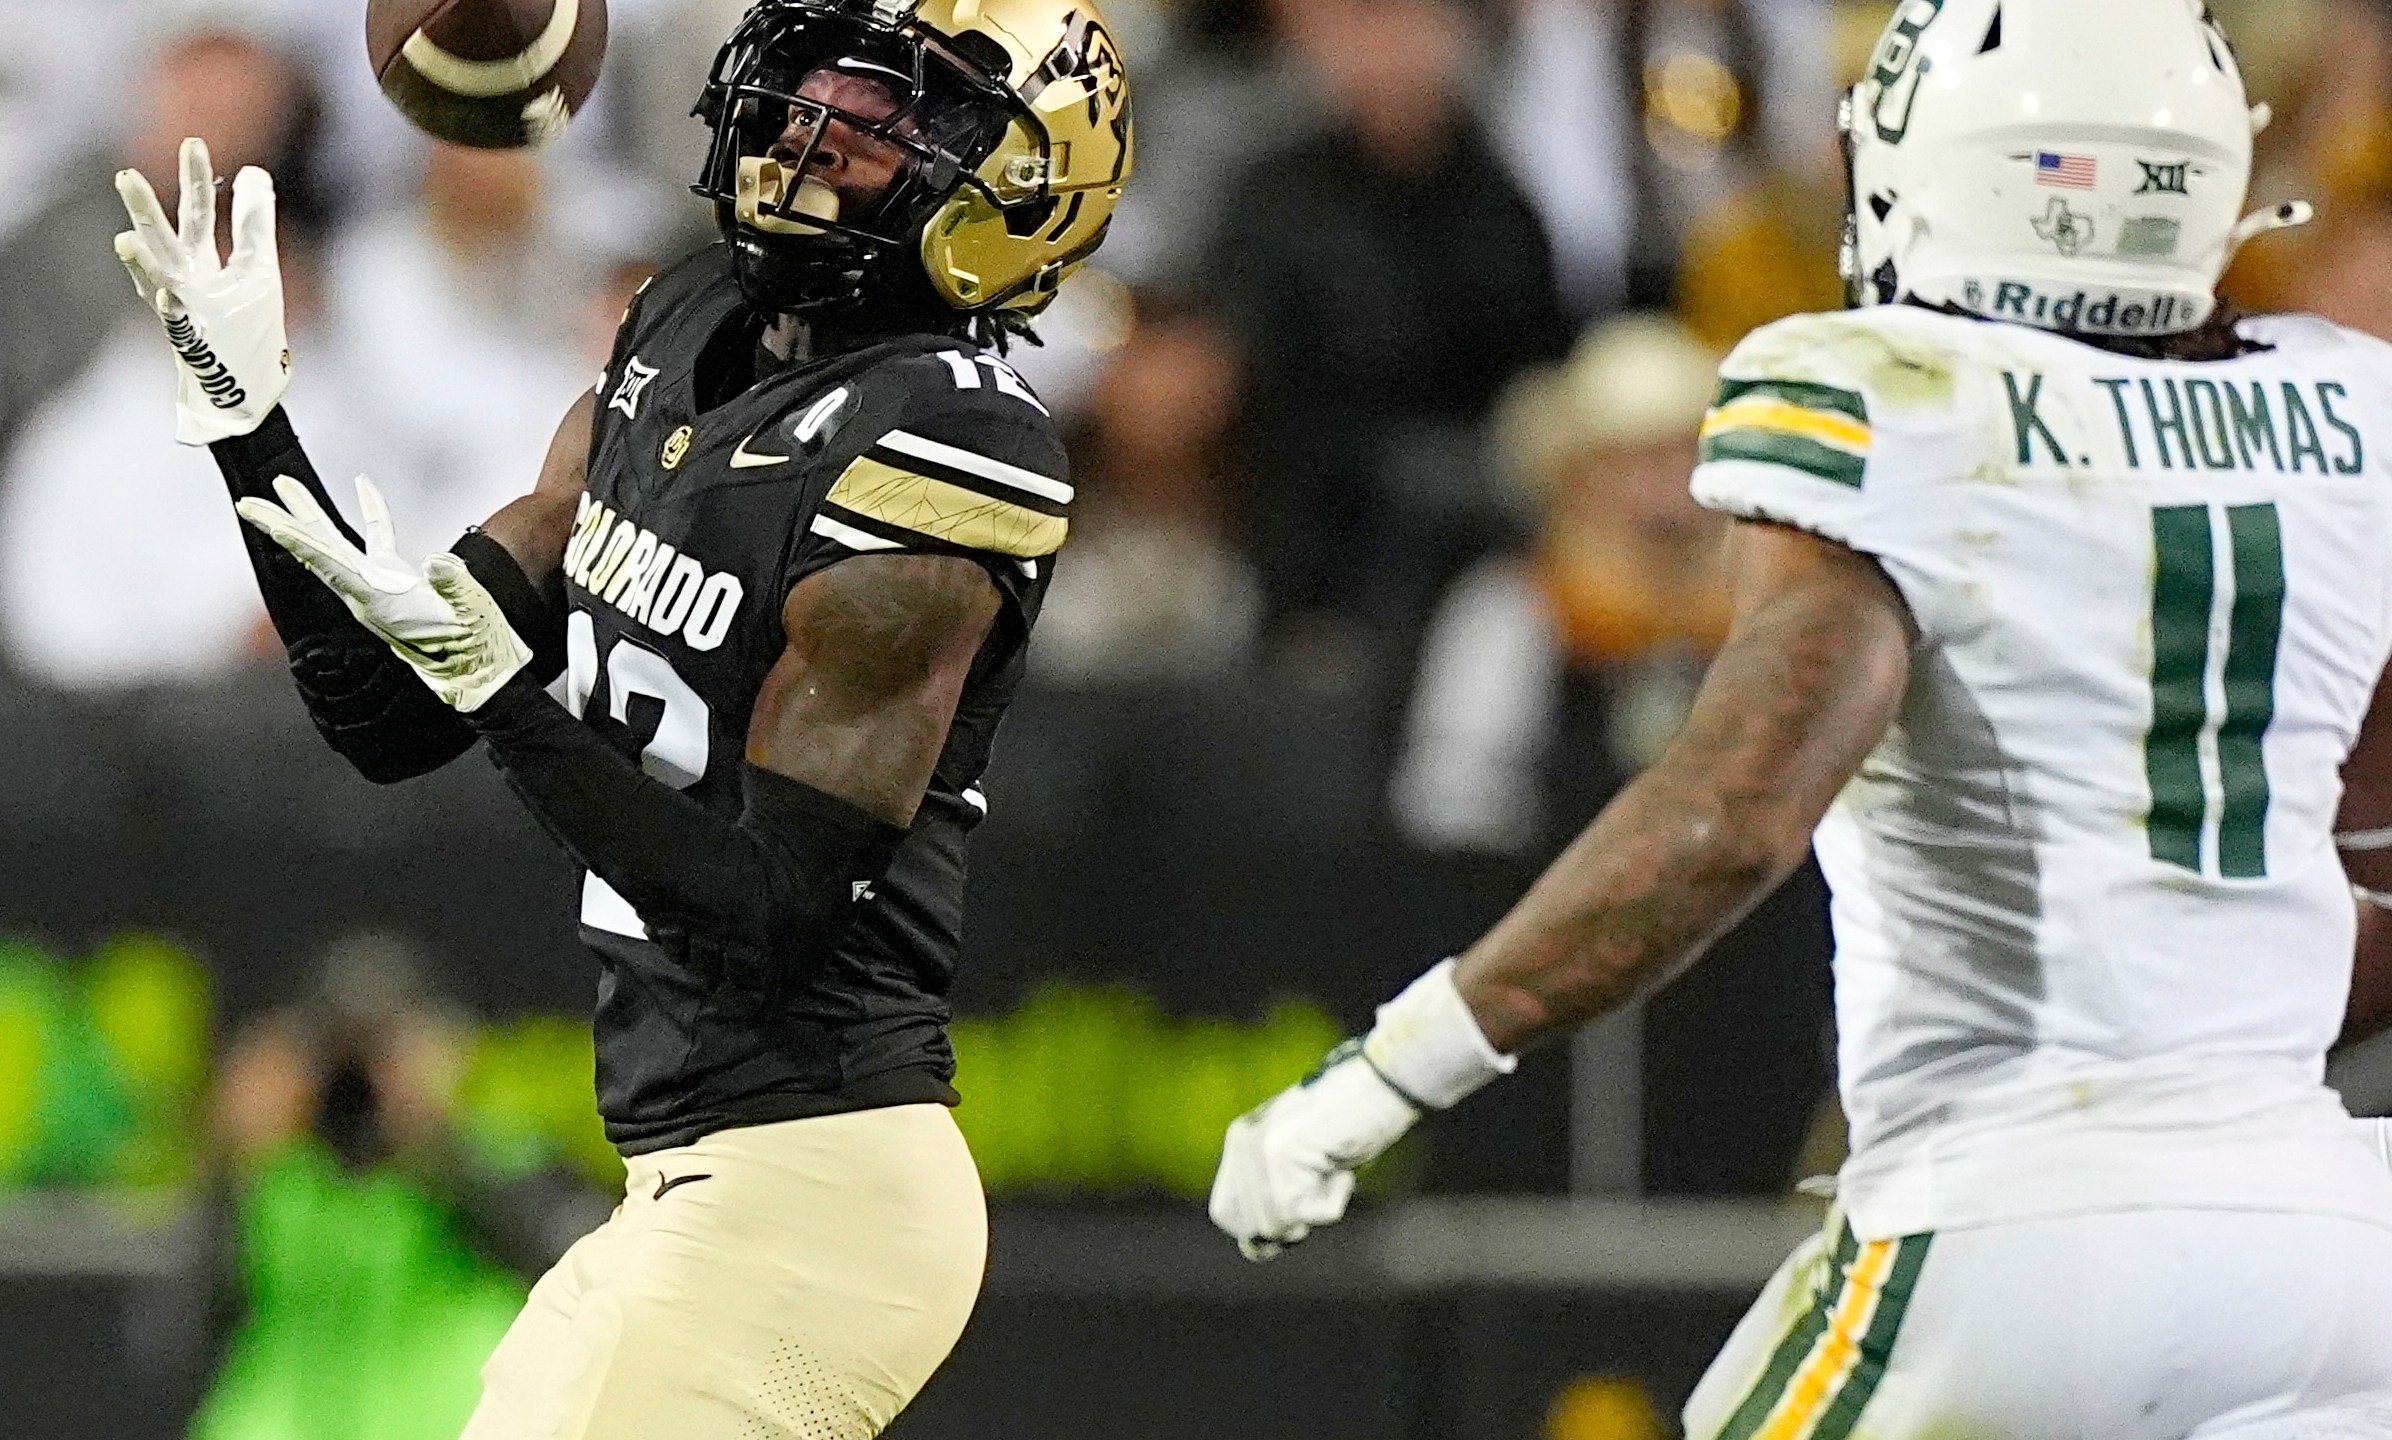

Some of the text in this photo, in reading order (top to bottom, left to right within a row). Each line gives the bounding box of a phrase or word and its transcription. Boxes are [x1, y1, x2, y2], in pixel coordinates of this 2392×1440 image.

[1995, 281, 2177, 328] Riddell
[2001, 370, 2364, 476] K. THOMAS
[562, 490, 744, 652] COLORADO
[2144, 501, 2287, 878] 11
